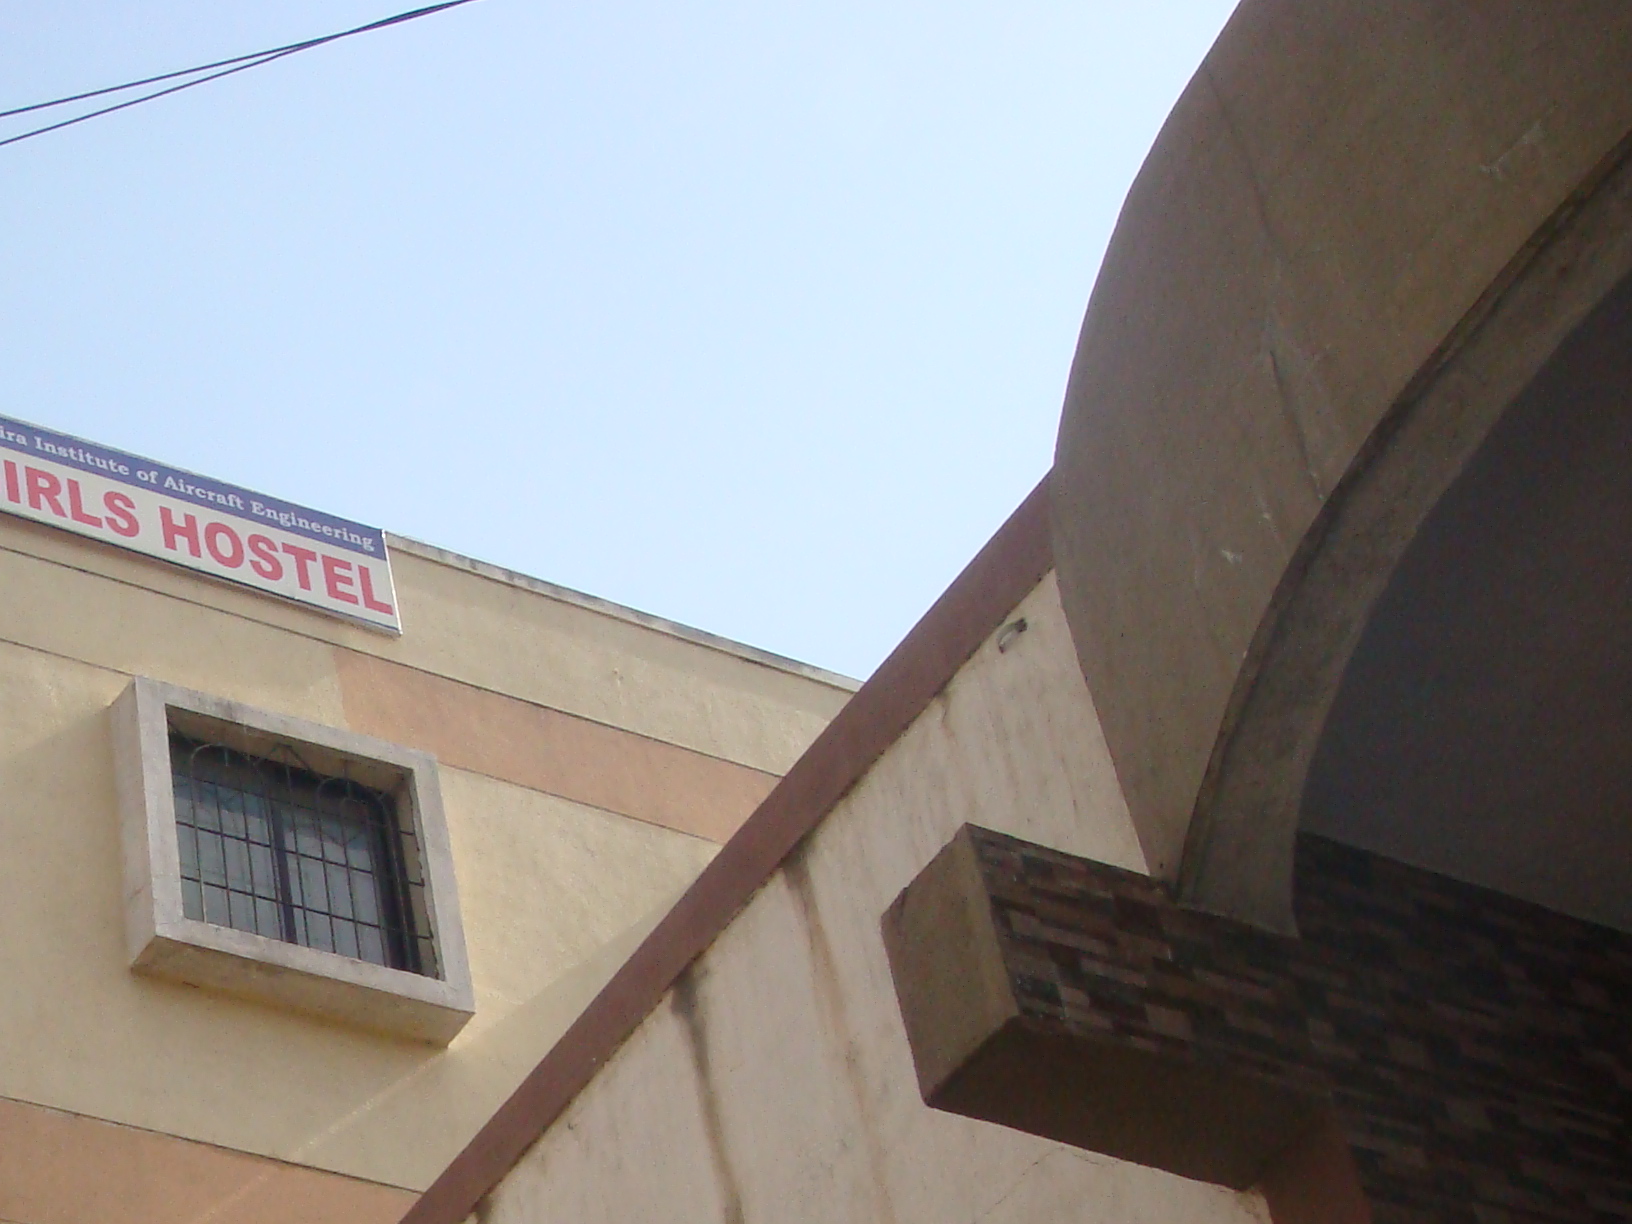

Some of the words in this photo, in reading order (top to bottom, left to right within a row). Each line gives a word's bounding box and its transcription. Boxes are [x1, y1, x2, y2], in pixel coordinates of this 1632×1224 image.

[33, 435, 130, 478] Institute
[136, 468, 159, 485] of
[163, 475, 245, 511] Aircraft
[251, 499, 375, 552] Engineering
[158, 504, 394, 616] HOSTEL
